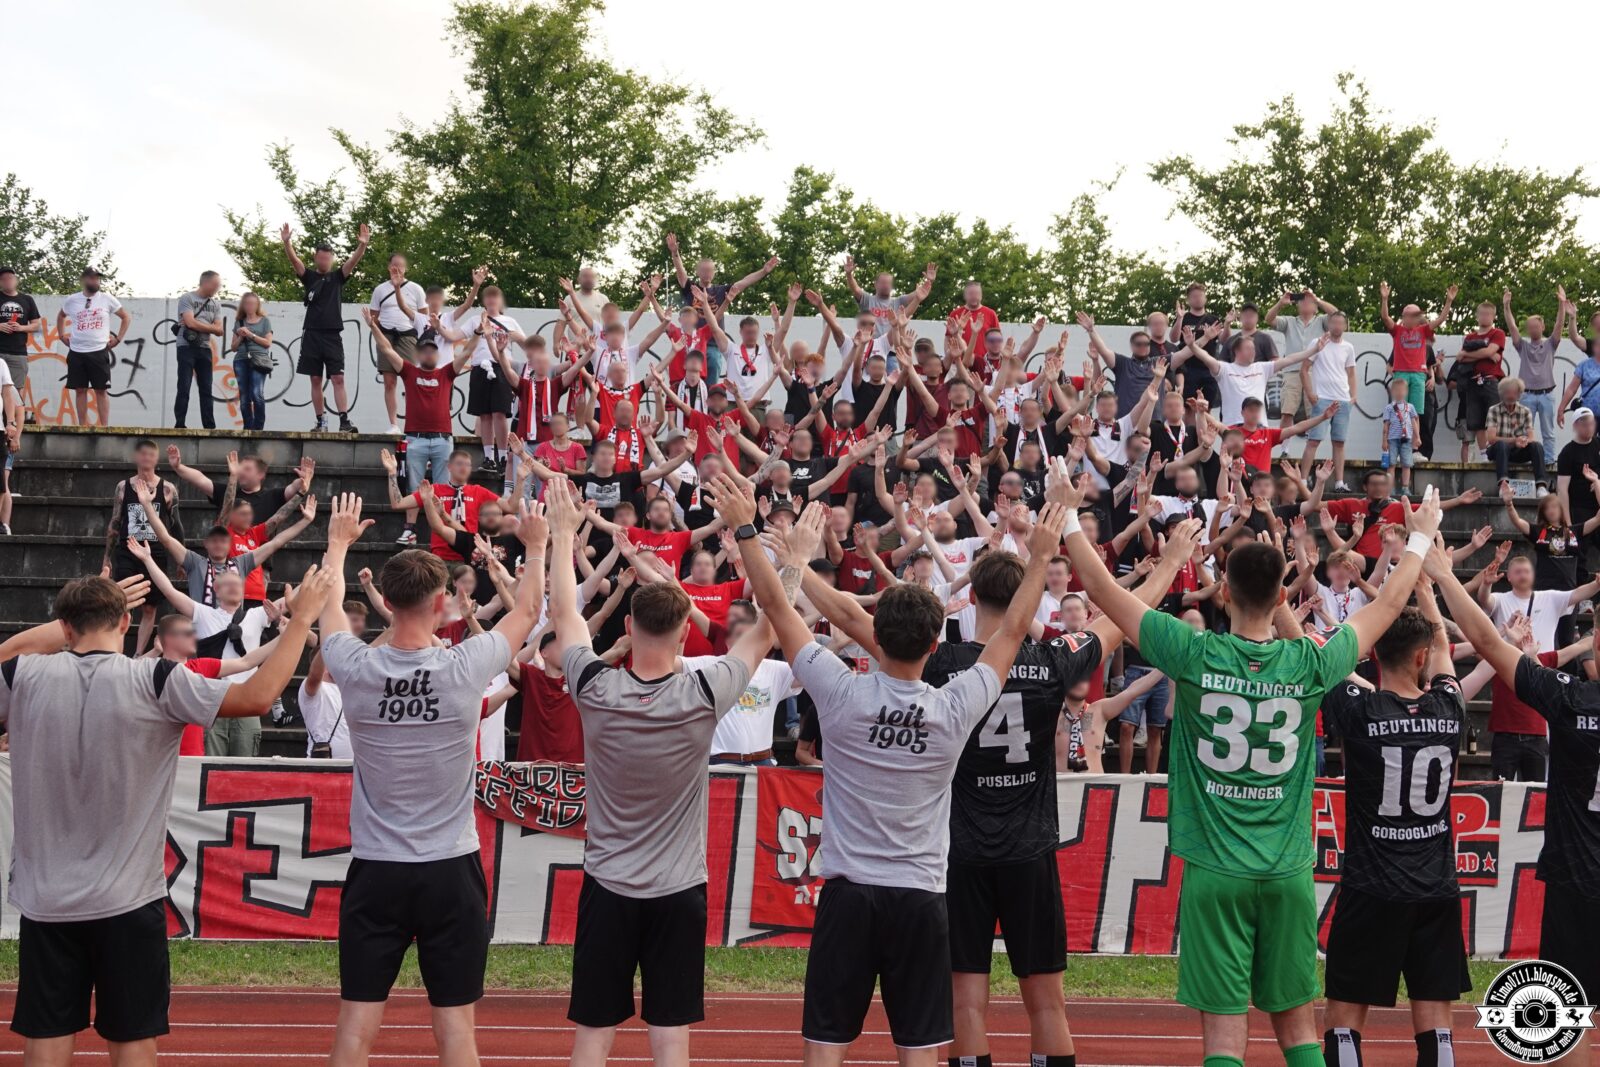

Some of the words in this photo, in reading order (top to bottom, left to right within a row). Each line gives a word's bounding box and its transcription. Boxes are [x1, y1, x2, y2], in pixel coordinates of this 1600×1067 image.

[383, 669, 434, 698] seit
[1201, 673, 1305, 697] REUTLINGEN
[378, 697, 440, 723] 1905
[876, 703, 926, 729] seit
[867, 724, 929, 755] 1905
[978, 691, 1031, 764] 4
[1197, 692, 1303, 776] 33
[1367, 718, 1460, 737] REUTLINGEN
[1205, 780, 1284, 800] HOZLINGER
[1378, 744, 1453, 817] 10
